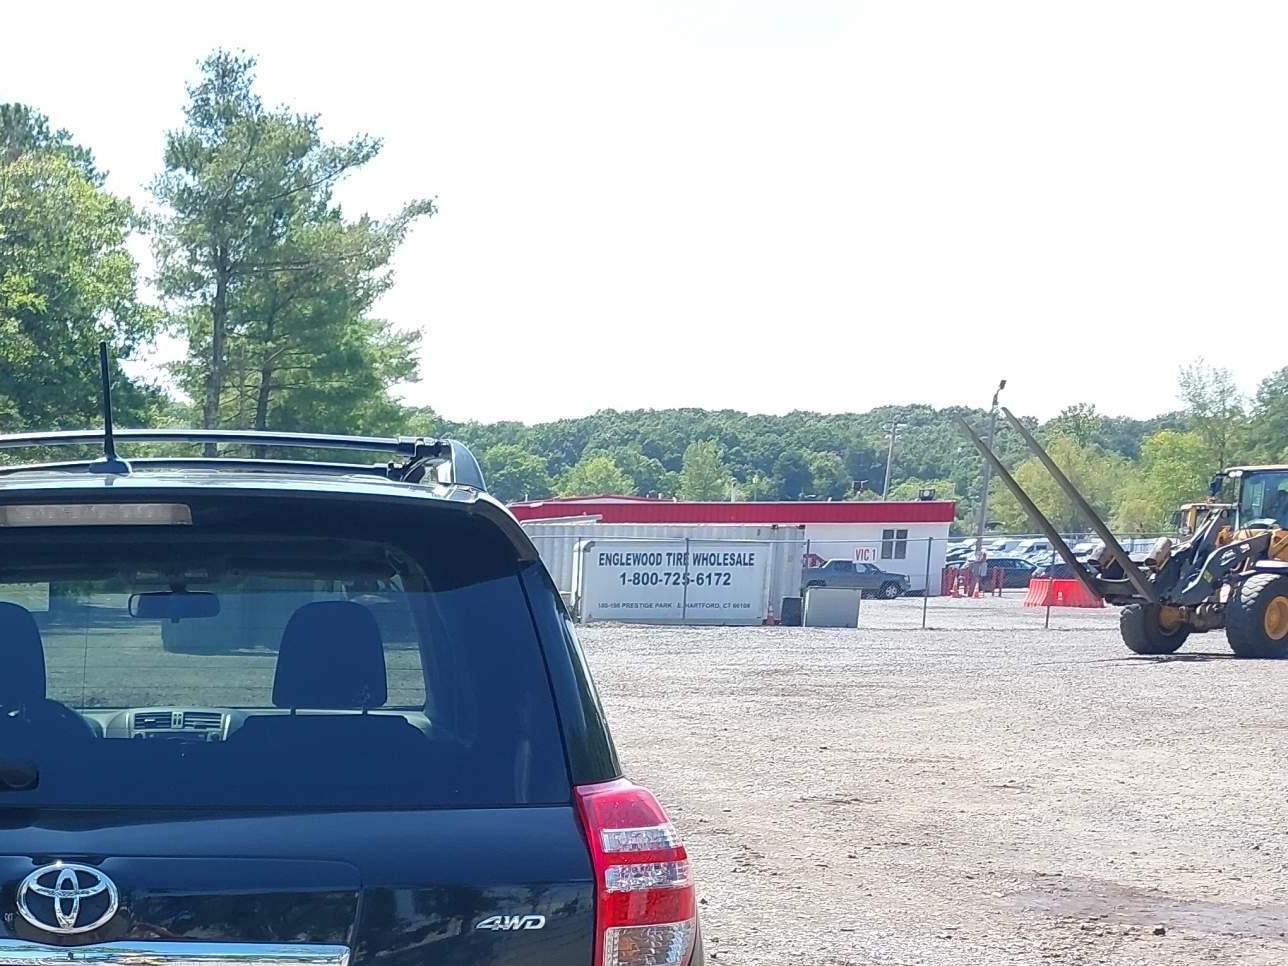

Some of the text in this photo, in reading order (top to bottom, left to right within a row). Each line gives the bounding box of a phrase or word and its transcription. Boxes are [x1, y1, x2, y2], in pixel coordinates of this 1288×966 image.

[598, 552, 755, 567] ENGLEWOOD TIRE WHOLESALE
[855, 548, 870, 561] VIC
[619, 572, 732, 586] 1-800-725-6172
[475, 915, 546, 930] 4WD
